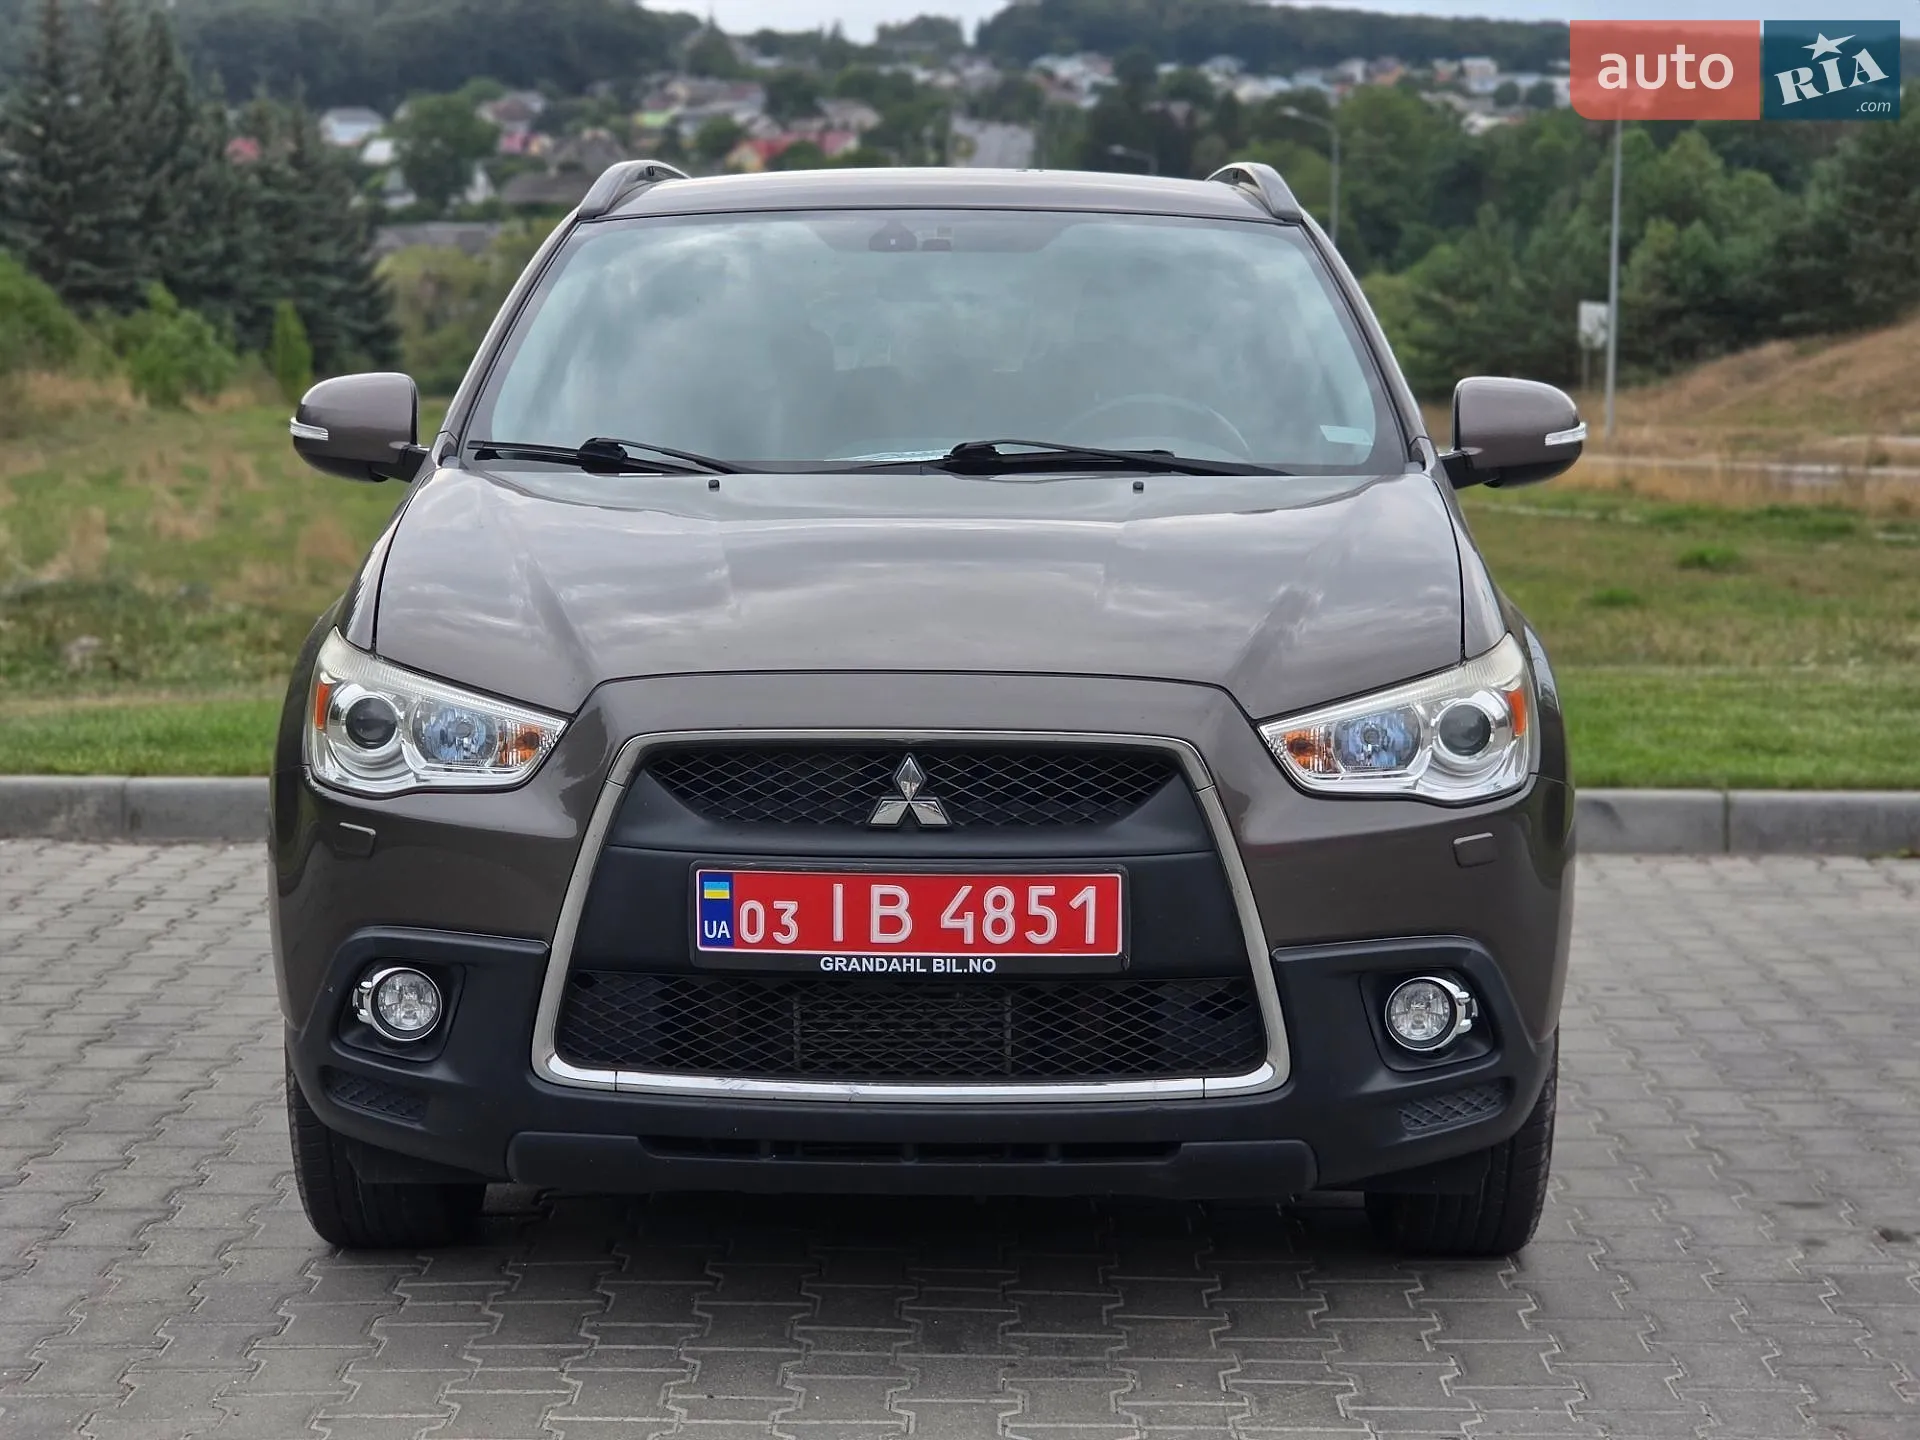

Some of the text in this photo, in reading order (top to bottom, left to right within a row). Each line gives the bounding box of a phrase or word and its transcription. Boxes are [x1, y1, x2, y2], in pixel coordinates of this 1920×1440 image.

[739, 899, 799, 944] 03
[940, 885, 1097, 945] 4851
[703, 920, 731, 939] UA
[819, 956, 997, 974] GRANDAHL BIL.NO
